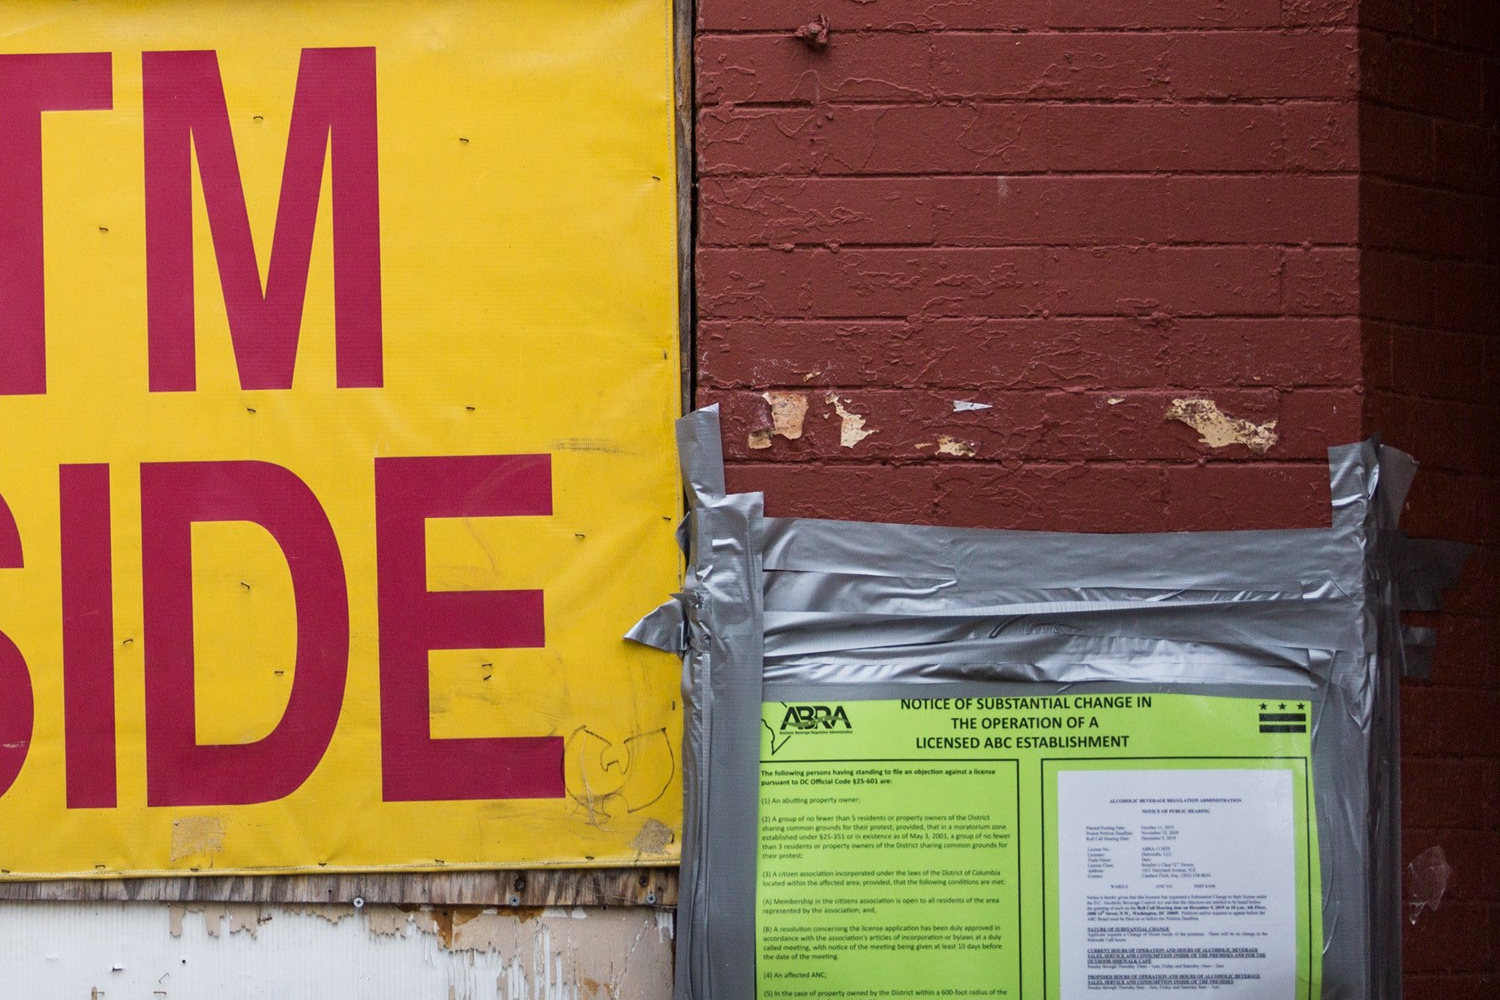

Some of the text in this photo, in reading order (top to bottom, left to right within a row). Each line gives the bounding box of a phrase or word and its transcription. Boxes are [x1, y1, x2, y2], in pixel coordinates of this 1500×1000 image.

[900, 695, 1152, 710] NOTICE OF SUBSTANTIAL CHANGE IN
[780, 706, 852, 730] ABRA
[952, 716, 1099, 729] THE OPERATION OF A
[916, 736, 1128, 749] LICENSED ABC ESTABLISHMENT
[775, 770, 805, 778] following
[832, 769, 854, 777] having
[856, 769, 883, 777] standing
[914, 769, 944, 777] objection
[945, 769, 967, 777] against
[762, 779, 790, 787] pursuant
[782, 797, 808, 805] abutting
[809, 797, 837, 805] property
[896, 815, 923, 823] property
[762, 825, 785, 833] sharing
[815, 824, 841, 832] grounds
[835, 870, 875, 878] incorporated
[773, 898, 814, 906] Membership
[763, 907, 801, 915] represented
[802, 907, 810, 915] by
[813, 926, 848, 934] concerning
[885, 925, 919, 933] application
[950, 925, 963, 933] duly
[964, 925, 994, 933] approved
[817, 990, 845, 998] property
[870, 990, 878, 998] by
